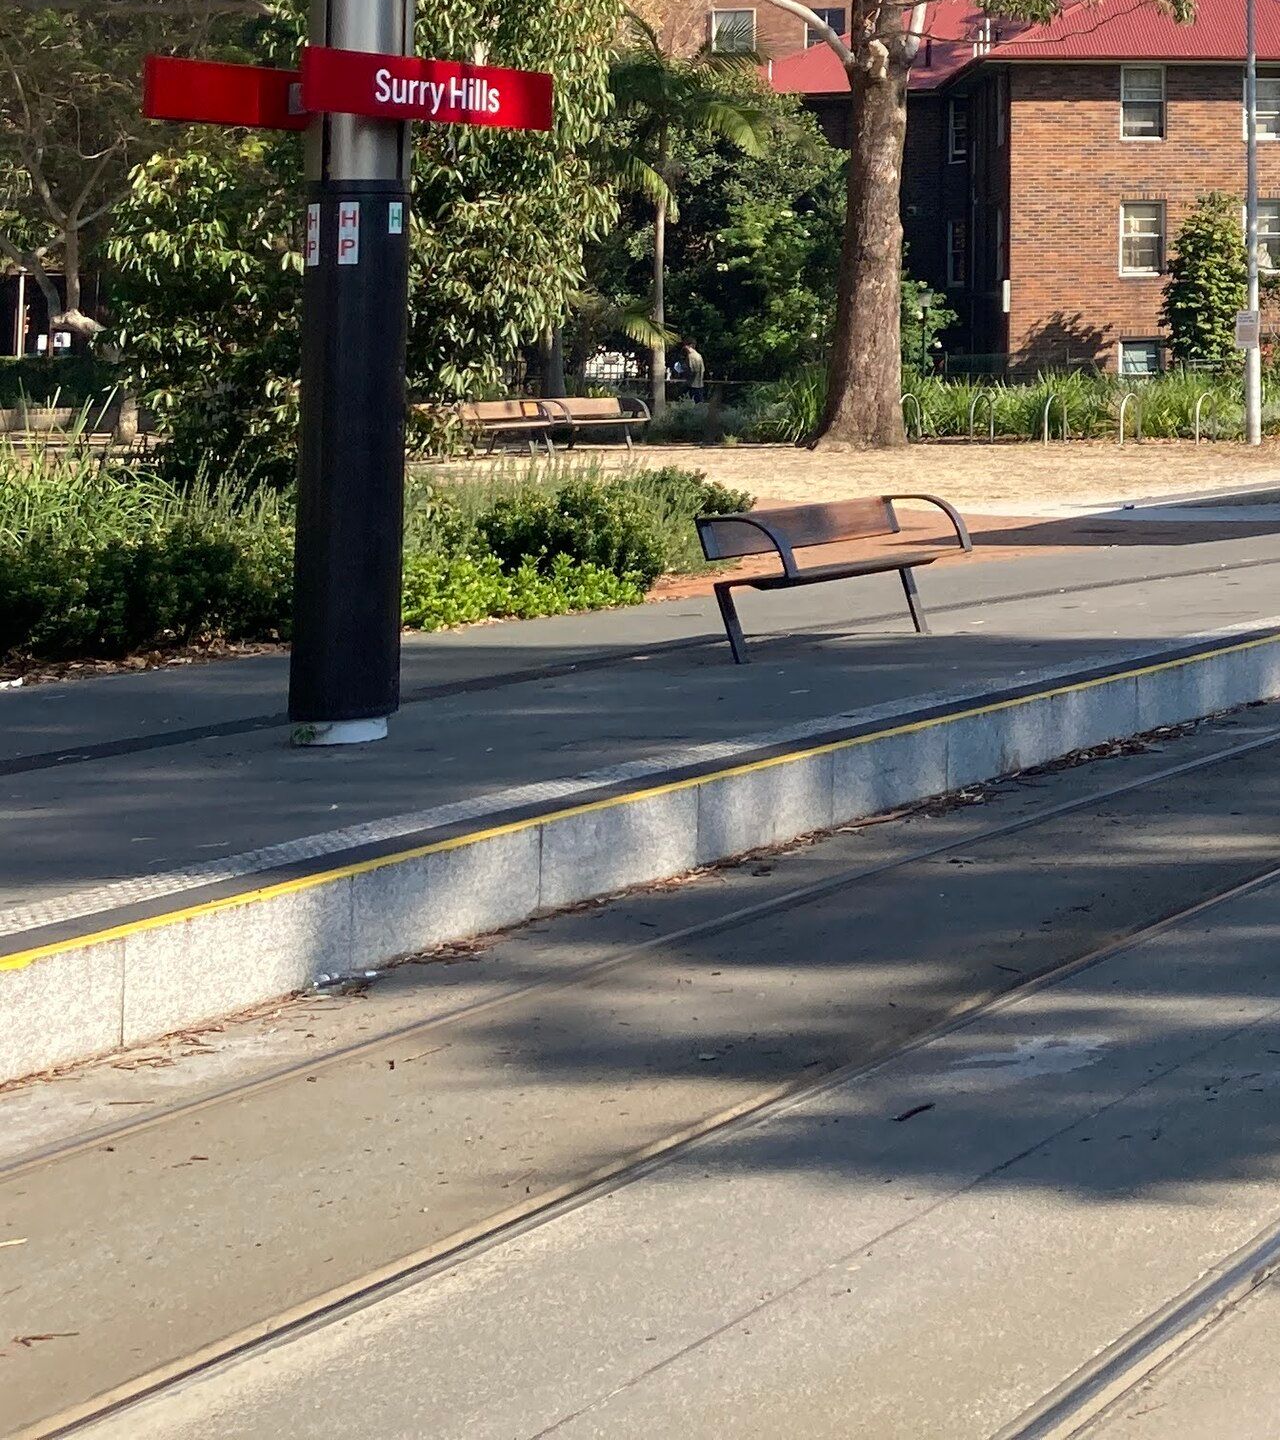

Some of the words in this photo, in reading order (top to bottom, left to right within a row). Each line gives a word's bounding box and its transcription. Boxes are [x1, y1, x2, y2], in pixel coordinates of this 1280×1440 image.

[375, 68, 445, 115] Surry
[450, 76, 500, 113] Hills
[390, 209, 401, 227] H
